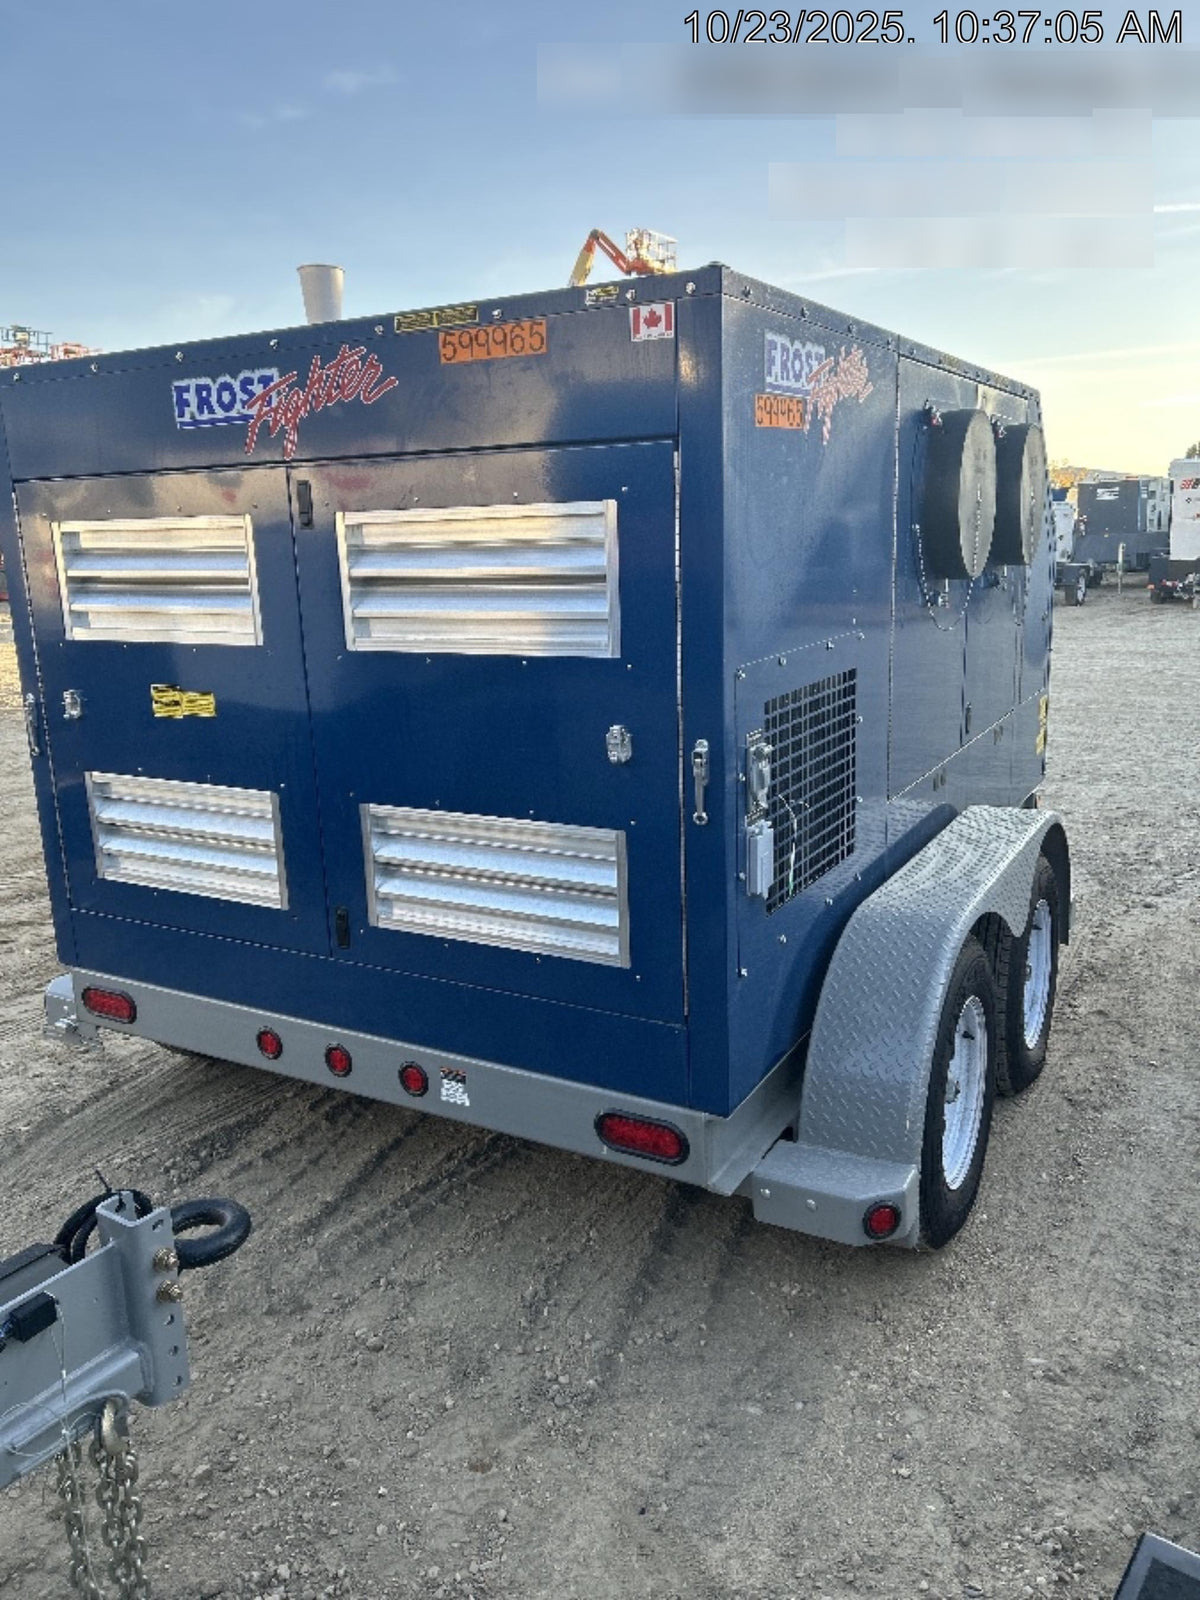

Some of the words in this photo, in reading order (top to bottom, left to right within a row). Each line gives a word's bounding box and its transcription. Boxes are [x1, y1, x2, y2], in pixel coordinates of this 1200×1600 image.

[440, 319, 547, 362] 599965
[173, 372, 275, 420] FROST
[244, 345, 399, 460] Fighter
